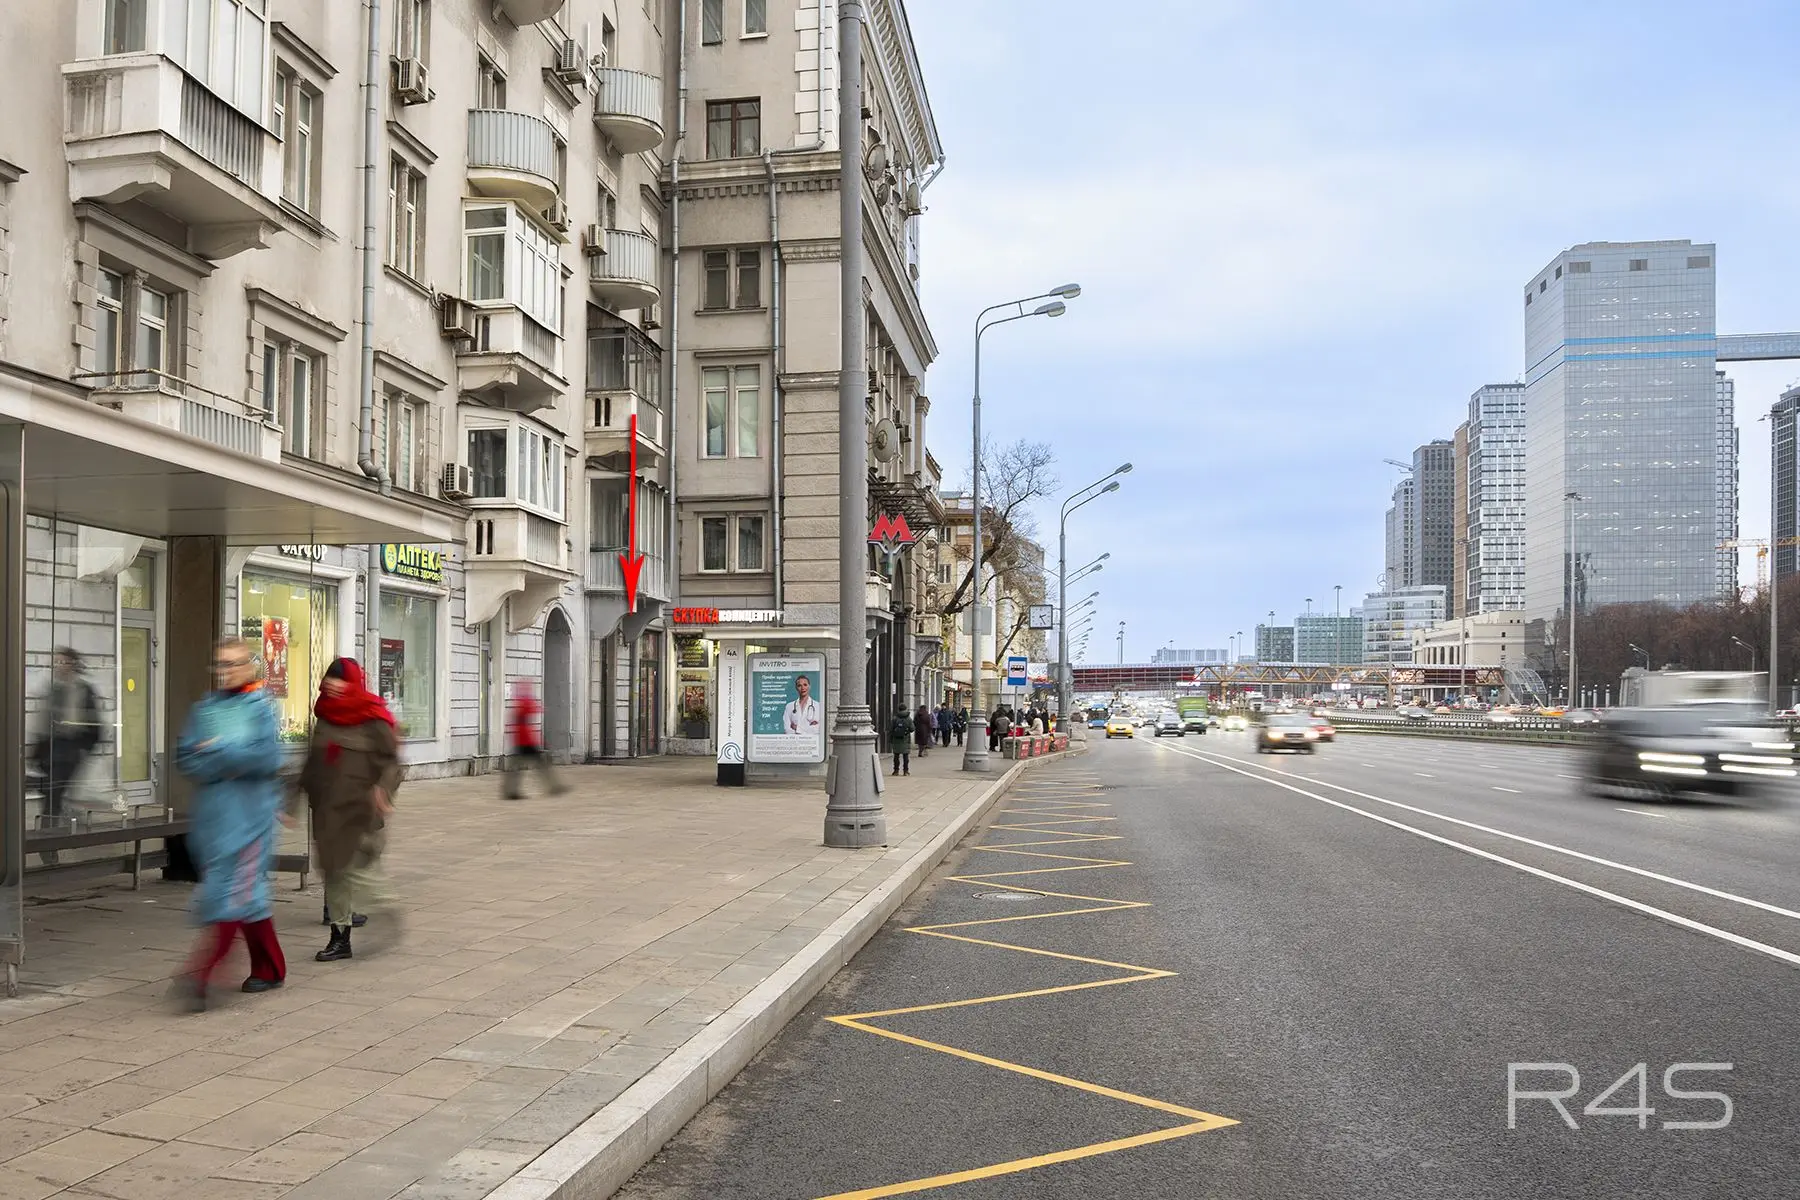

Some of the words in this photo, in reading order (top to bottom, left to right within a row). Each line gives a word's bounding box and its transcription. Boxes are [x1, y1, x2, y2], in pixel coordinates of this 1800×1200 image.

[397, 543, 443, 571] АПТЕКА
[397, 564, 420, 578] ПЛАНЕТА
[673, 607, 719, 624] СКУПКА
